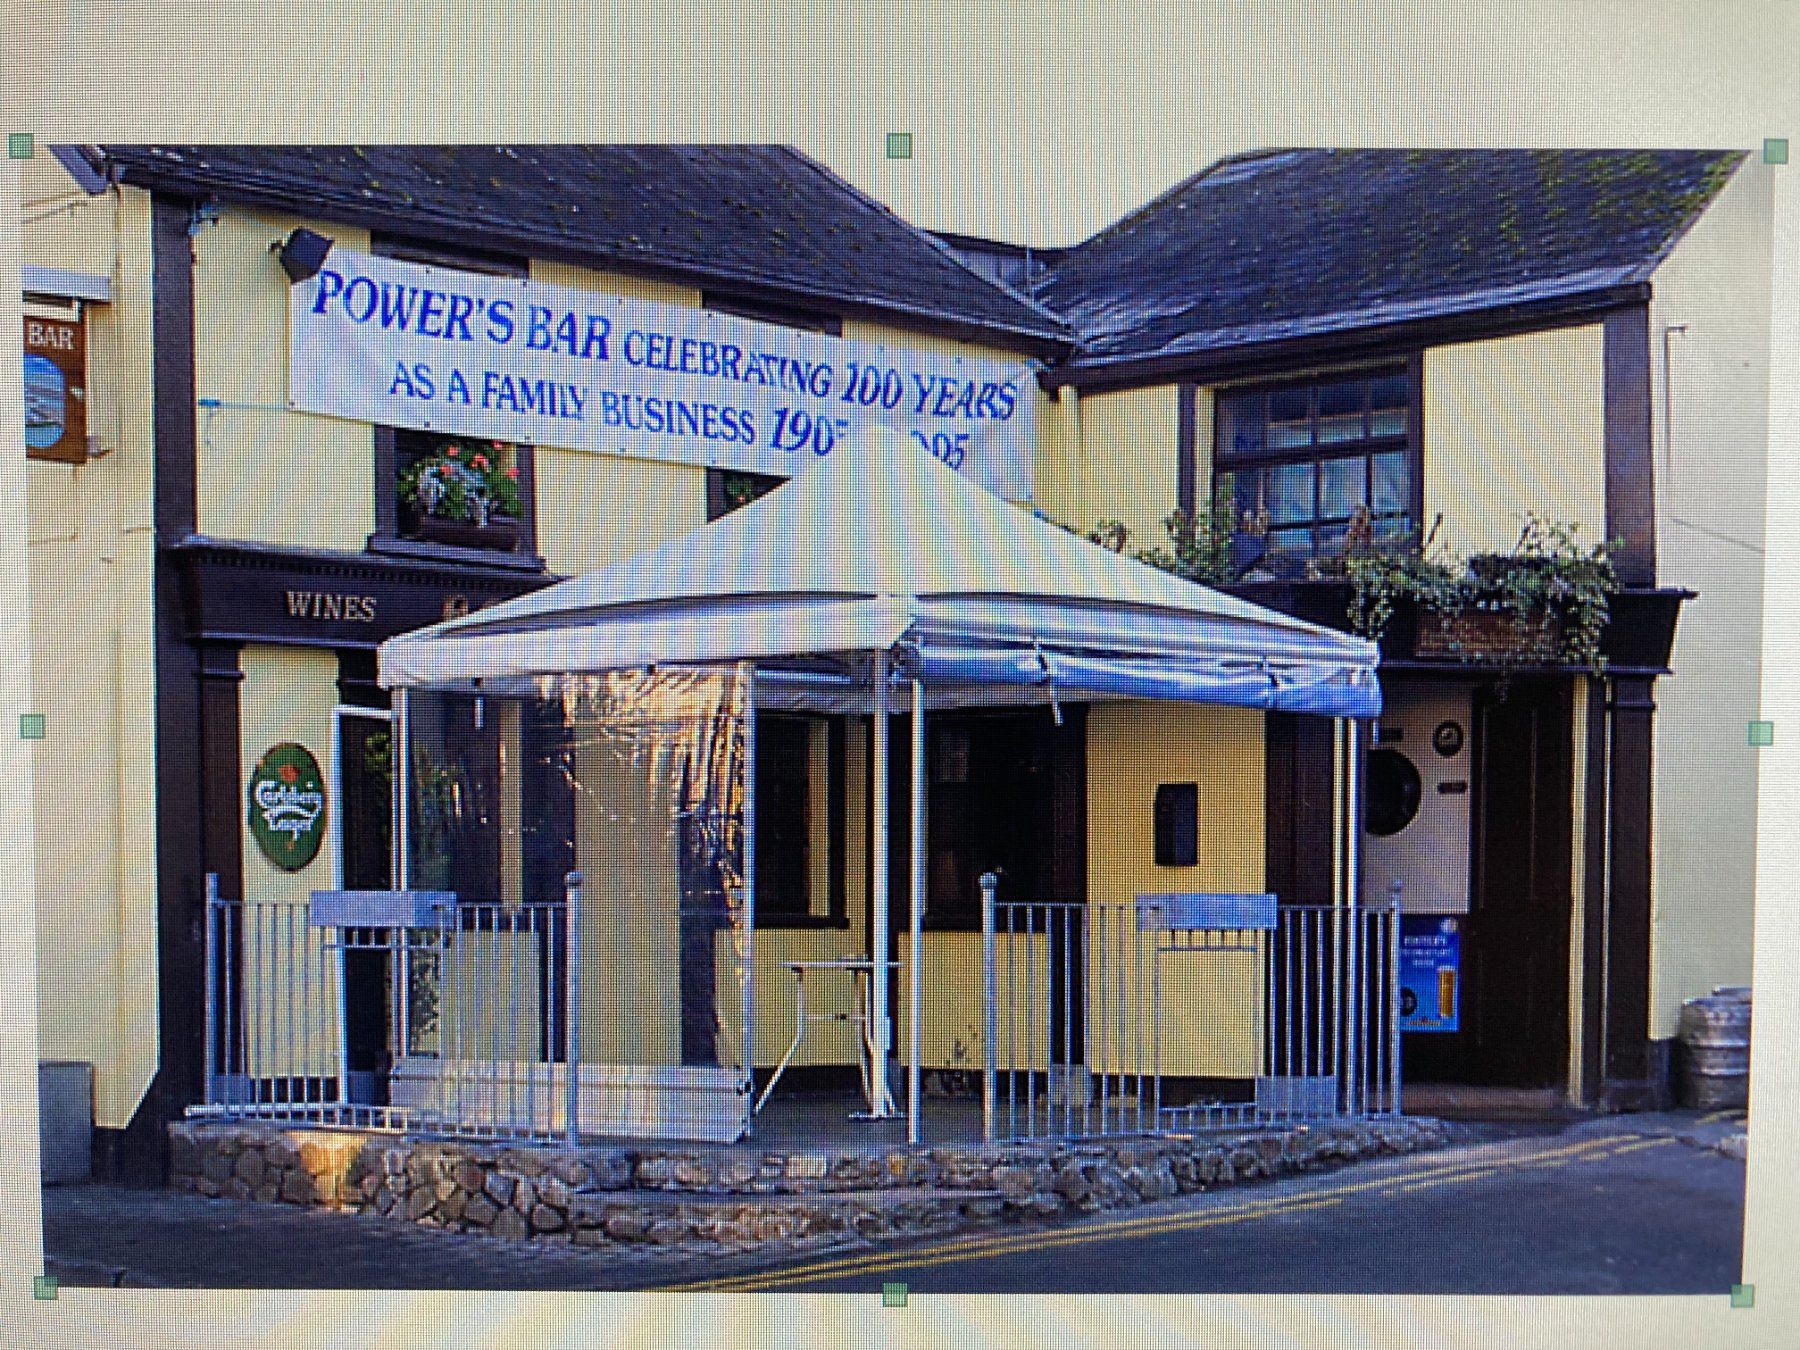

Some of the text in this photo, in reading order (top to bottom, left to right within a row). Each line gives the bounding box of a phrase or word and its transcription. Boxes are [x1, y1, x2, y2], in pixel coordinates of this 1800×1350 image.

[28, 321, 75, 350] BAR
[311, 270, 1018, 421] POWER'S BAR CELEBRATING 100 YEARS
[390, 361, 435, 400] AS
[448, 368, 471, 404] A
[481, 370, 587, 420] FAMILY
[601, 390, 755, 445] BUSINESS
[286, 590, 377, 622] WINES
